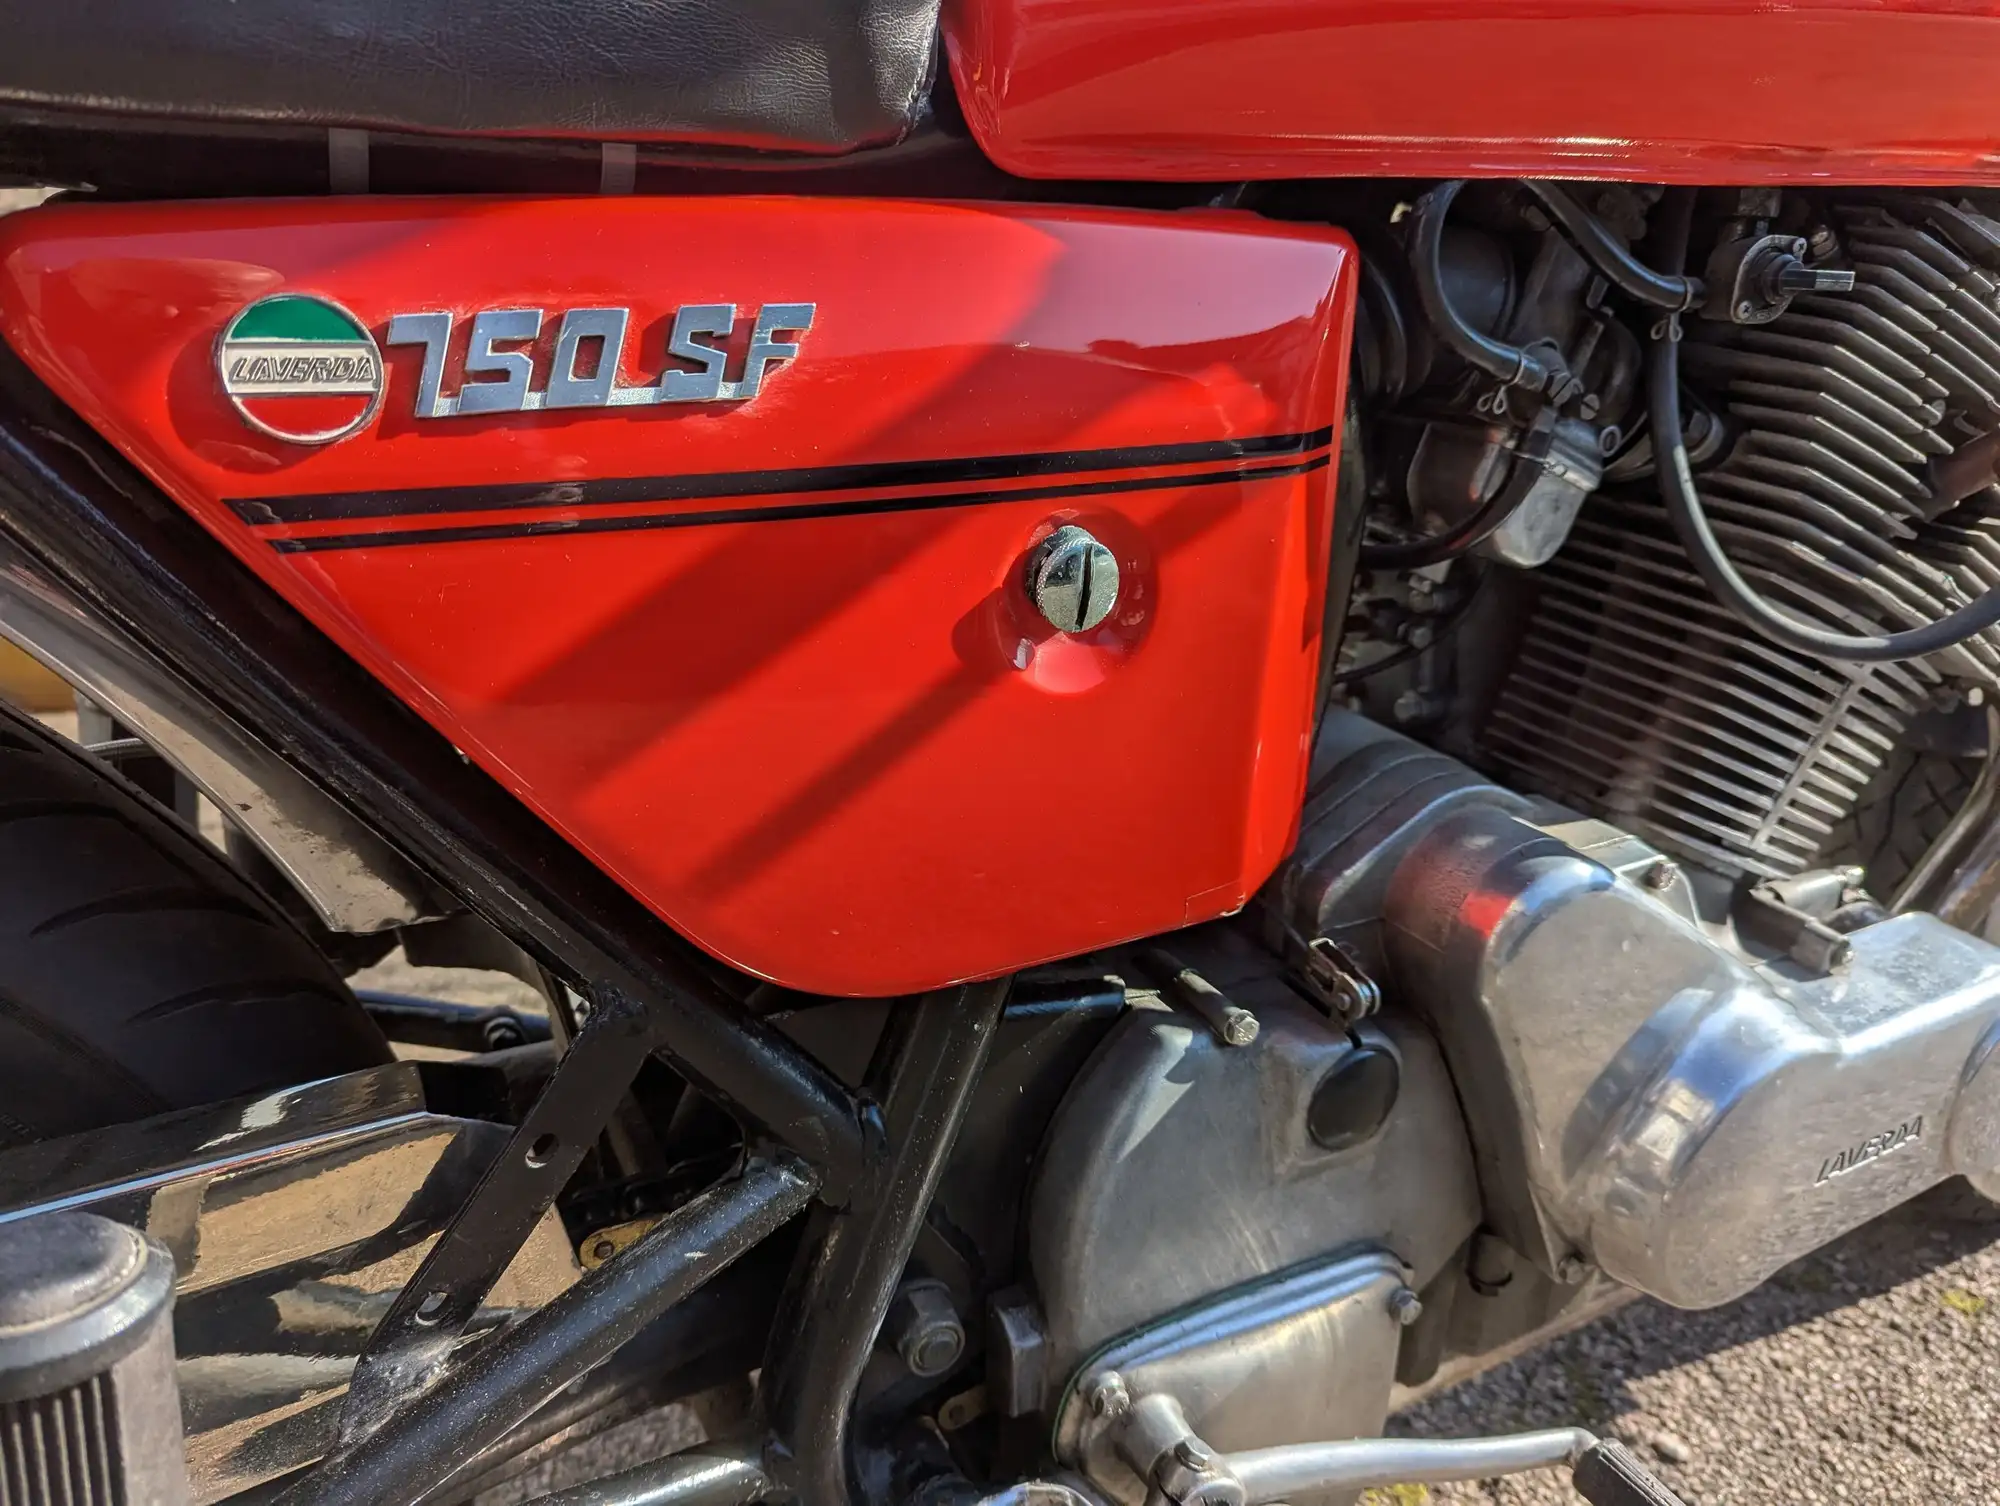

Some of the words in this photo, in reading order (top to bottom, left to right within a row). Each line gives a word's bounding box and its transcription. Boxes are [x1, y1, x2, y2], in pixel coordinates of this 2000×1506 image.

[229, 355, 376, 384] LAVERDA
[387, 307, 629, 418] 750
[659, 303, 816, 402] SF
[1814, 1115, 1923, 1186] LAVERDA
